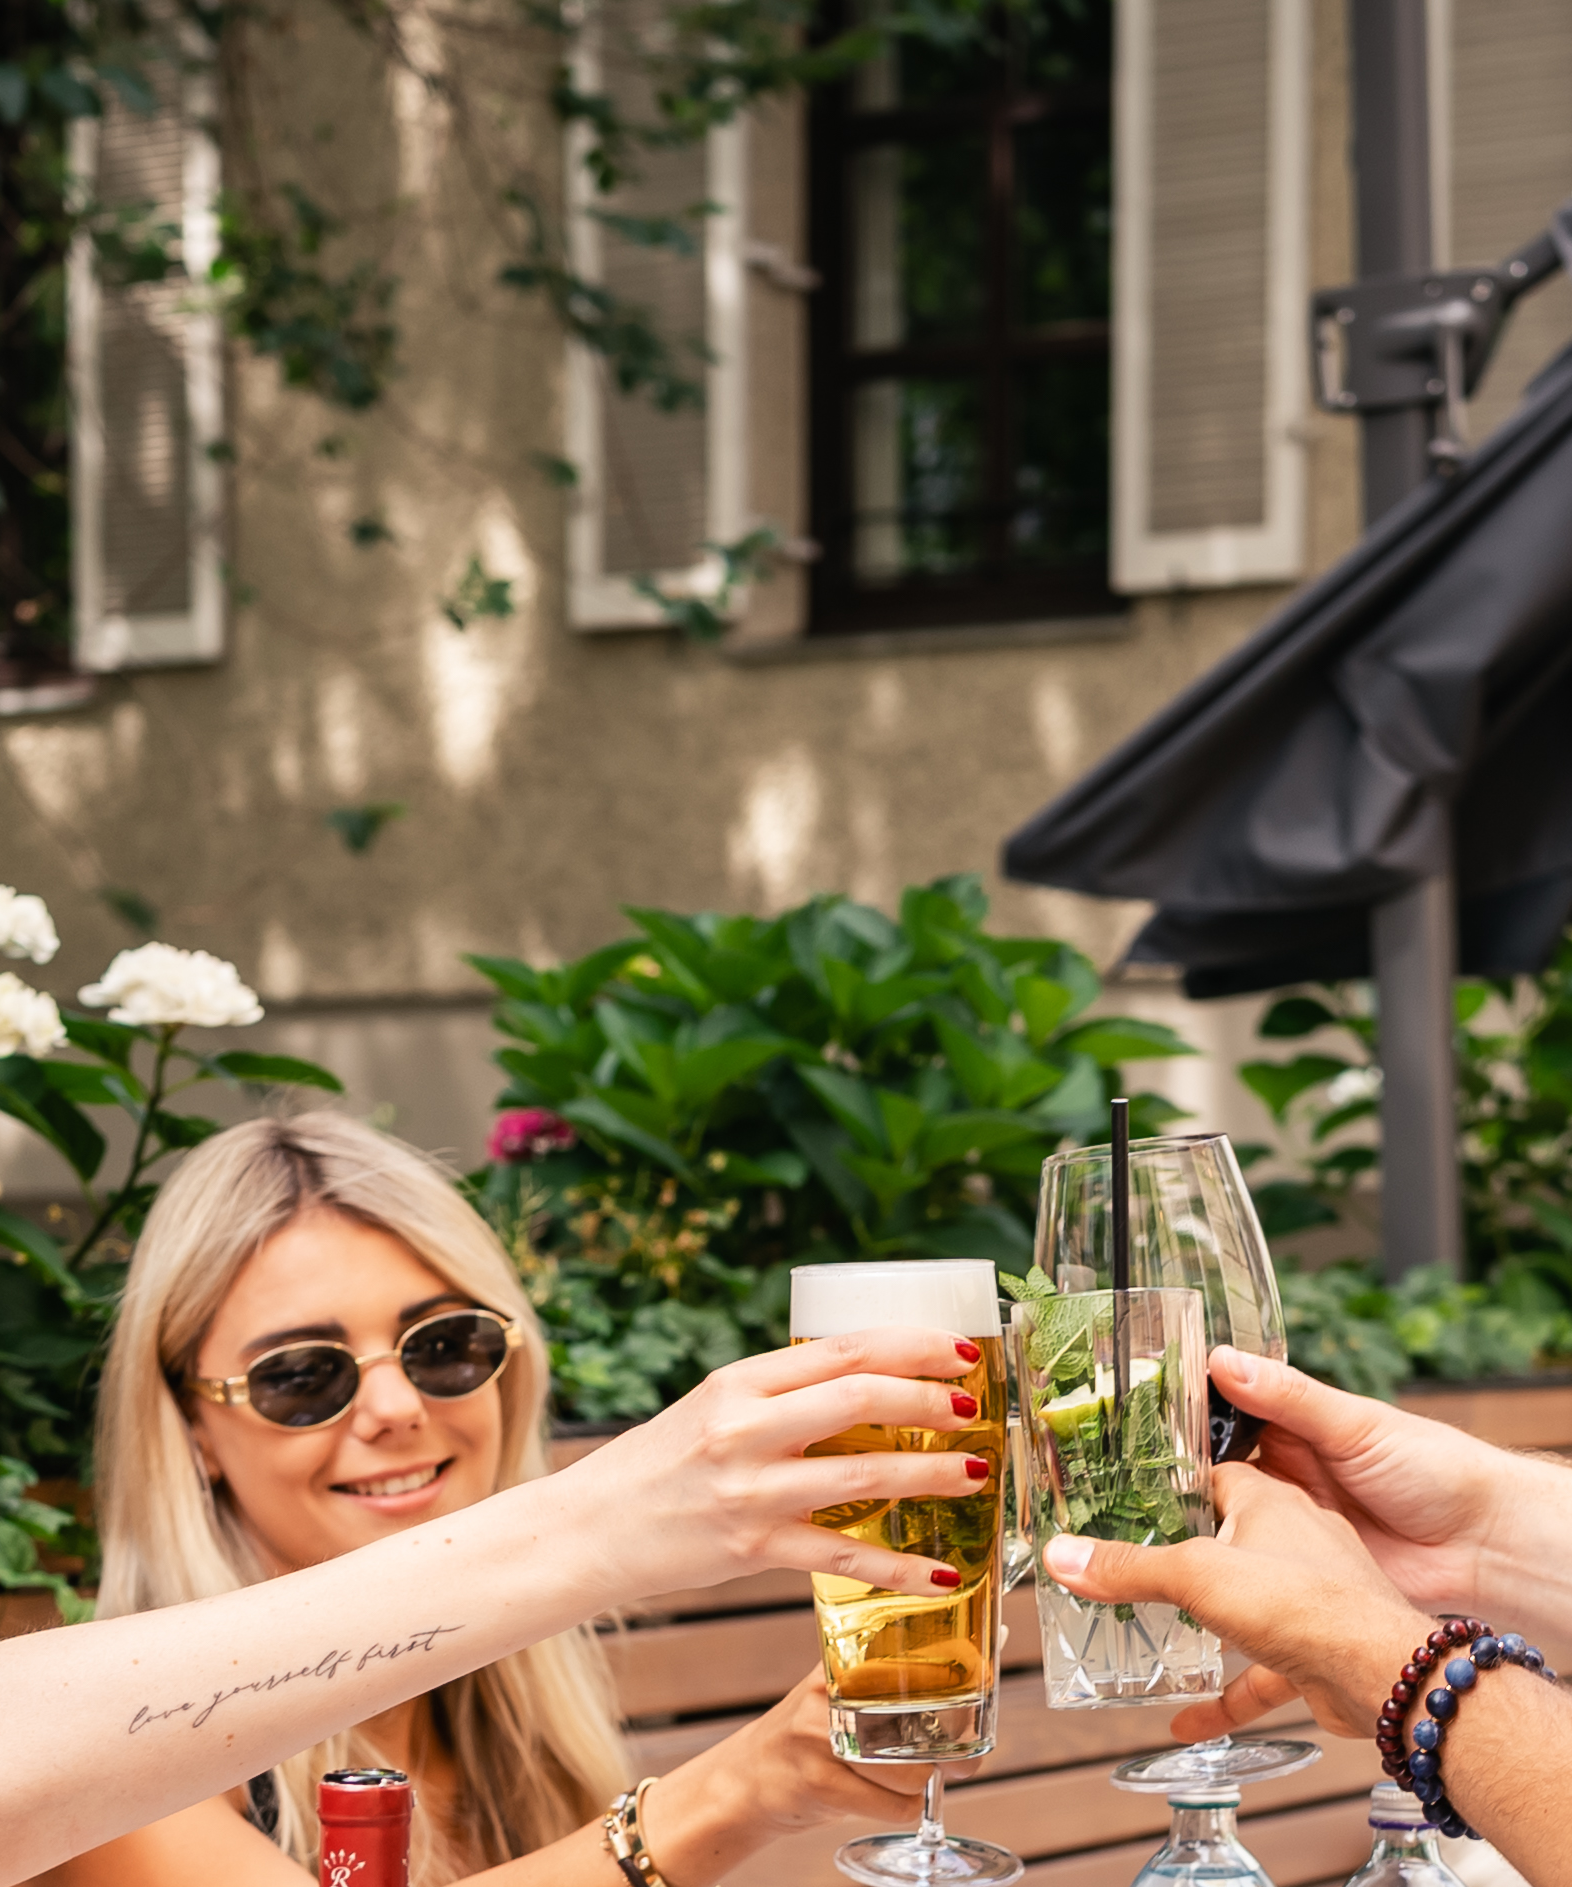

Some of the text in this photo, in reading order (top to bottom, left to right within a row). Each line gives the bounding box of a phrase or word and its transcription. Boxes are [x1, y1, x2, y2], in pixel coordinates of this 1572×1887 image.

[128, 1624, 467, 1735] love yourself first
